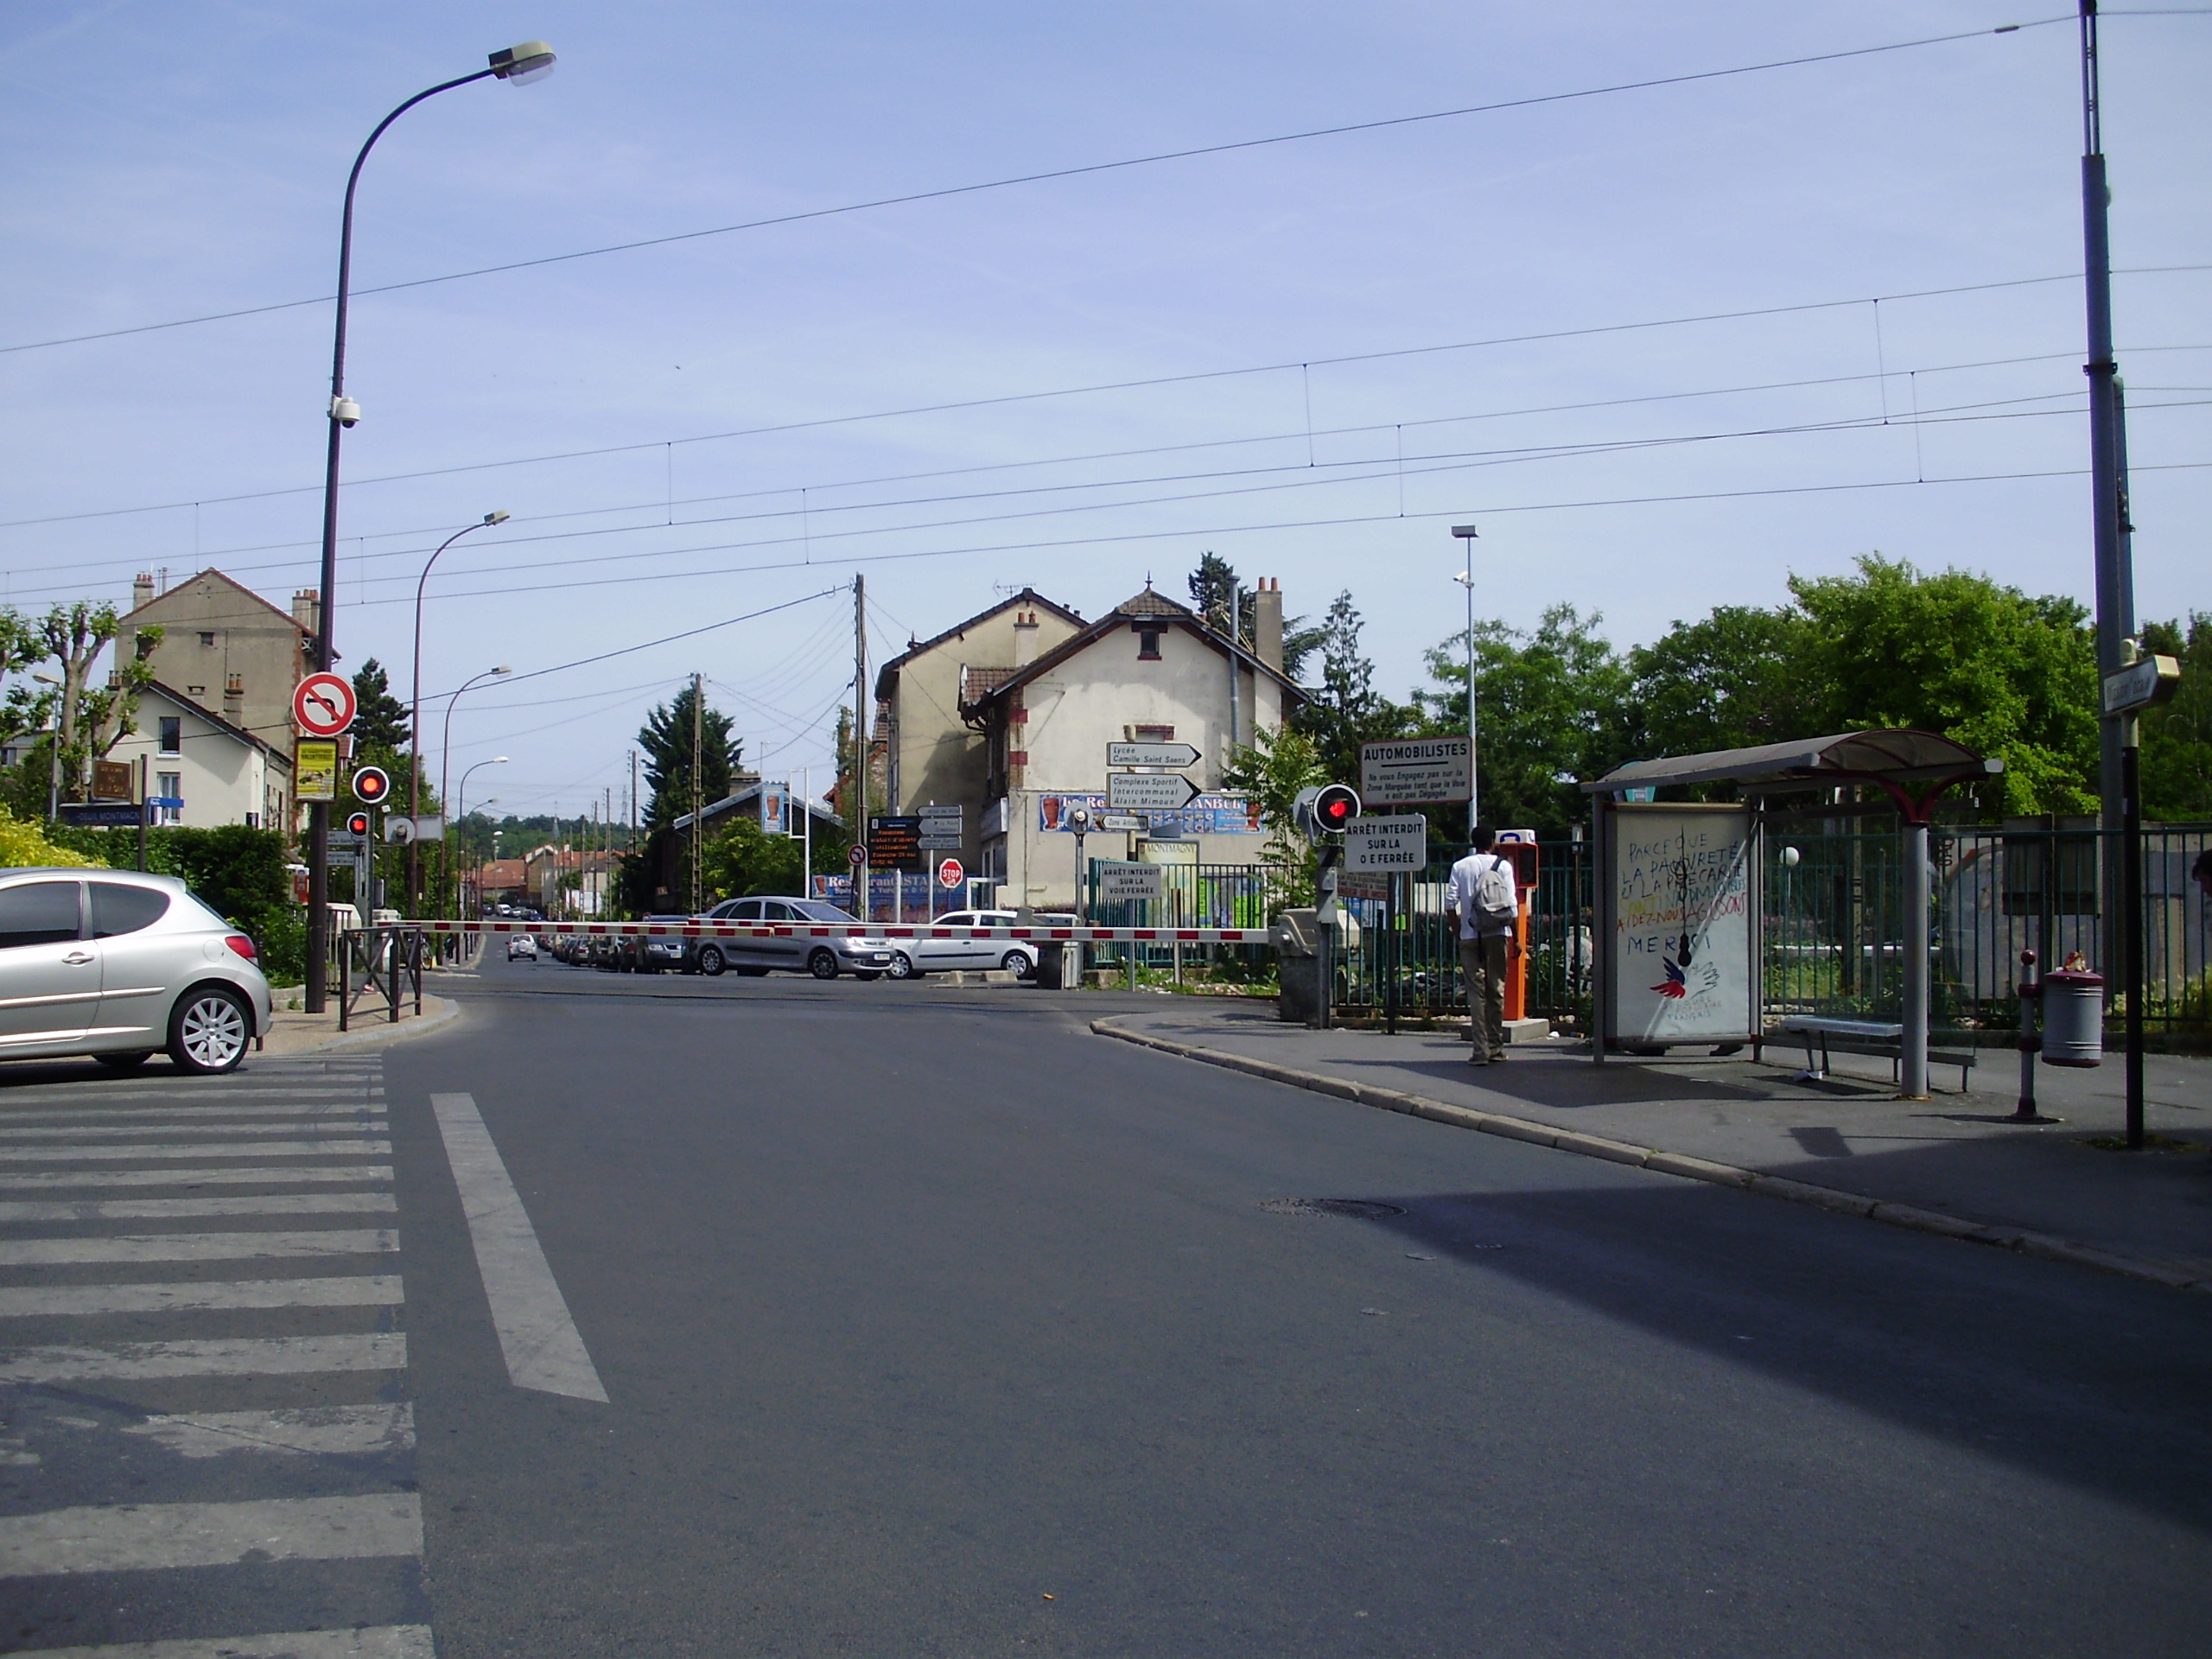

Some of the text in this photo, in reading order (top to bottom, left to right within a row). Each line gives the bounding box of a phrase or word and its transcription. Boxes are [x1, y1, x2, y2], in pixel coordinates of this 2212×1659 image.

[1364, 744, 1467, 761] AUTOMOBILISTES
[1397, 772, 1425, 781] Engagez
[1427, 771, 1440, 779] pas
[1113, 778, 1178, 786] Complexe Sportif
[1366, 784, 1382, 792] Zone
[1430, 781, 1442, 790] que
[1404, 791, 1416, 800] pas
[1346, 823, 1422, 836] ARRÊT INTERDIT
[1367, 839, 1401, 849] SUR LA
[1675, 833, 1708, 850] QUE
[1147, 843, 1195, 853] MONTMAGNY
[1378, 852, 1414, 864] FERRÉE
[1103, 868, 1127, 876] ARRÊT
[1623, 868, 1643, 885] LA
[1642, 879, 1662, 899] LA
[1628, 932, 1711, 956] MERCI
